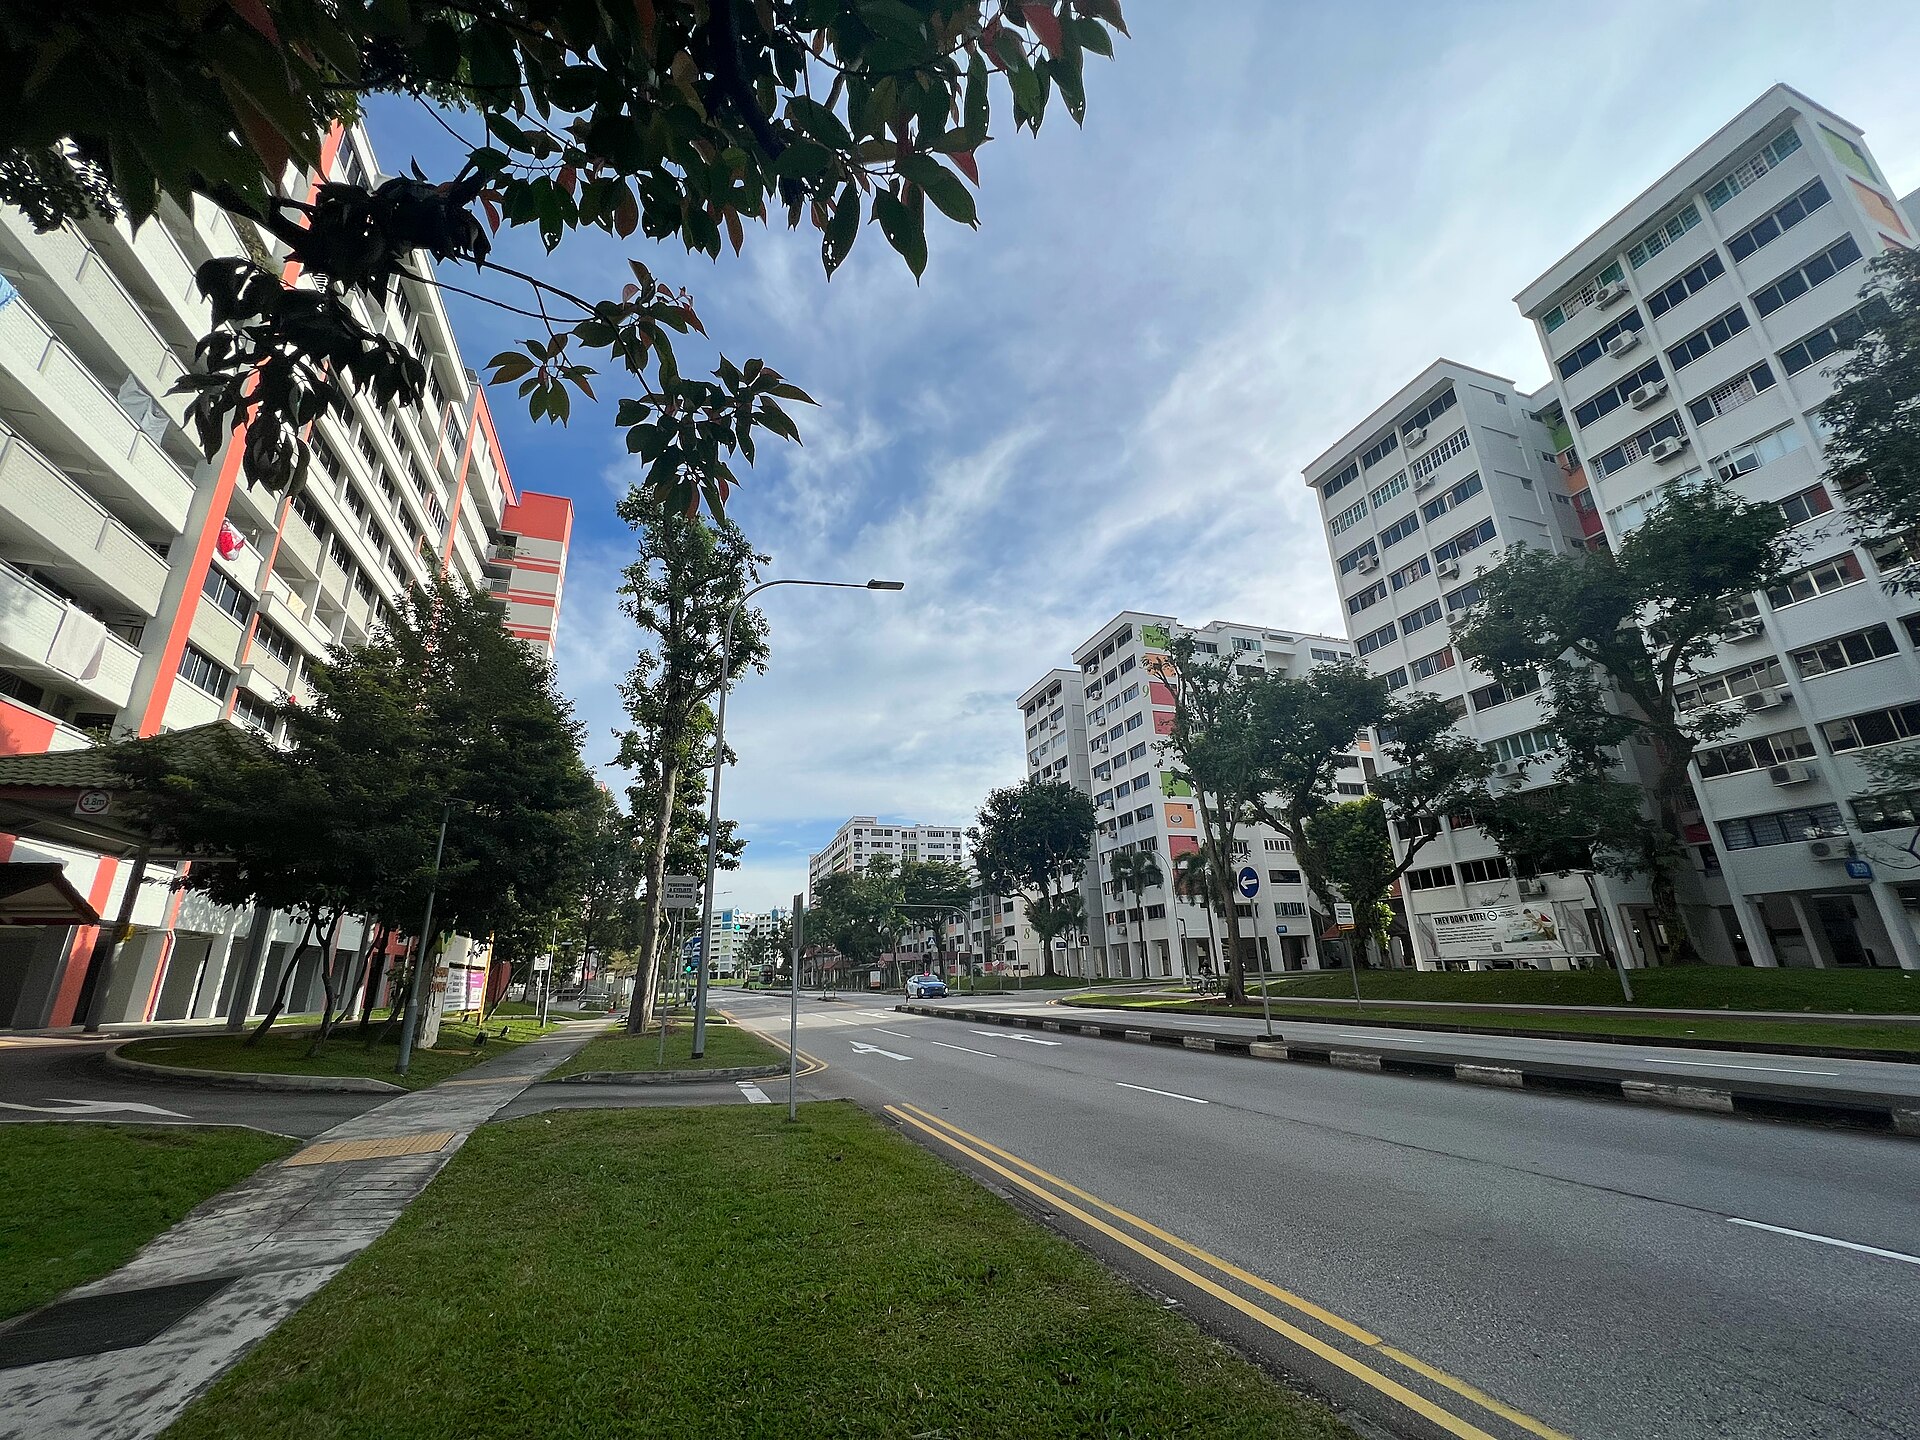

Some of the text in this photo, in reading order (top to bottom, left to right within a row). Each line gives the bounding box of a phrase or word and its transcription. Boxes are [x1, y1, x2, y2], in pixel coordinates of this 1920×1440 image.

[1142, 685, 1149, 698] 9
[83, 797, 105, 806] 3.8m
[1433, 916, 1450, 925] THEY
[1450, 914, 1470, 924] DON'T
[1469, 912, 1487, 922] BITE!
[1024, 927, 1030, 940] 8
